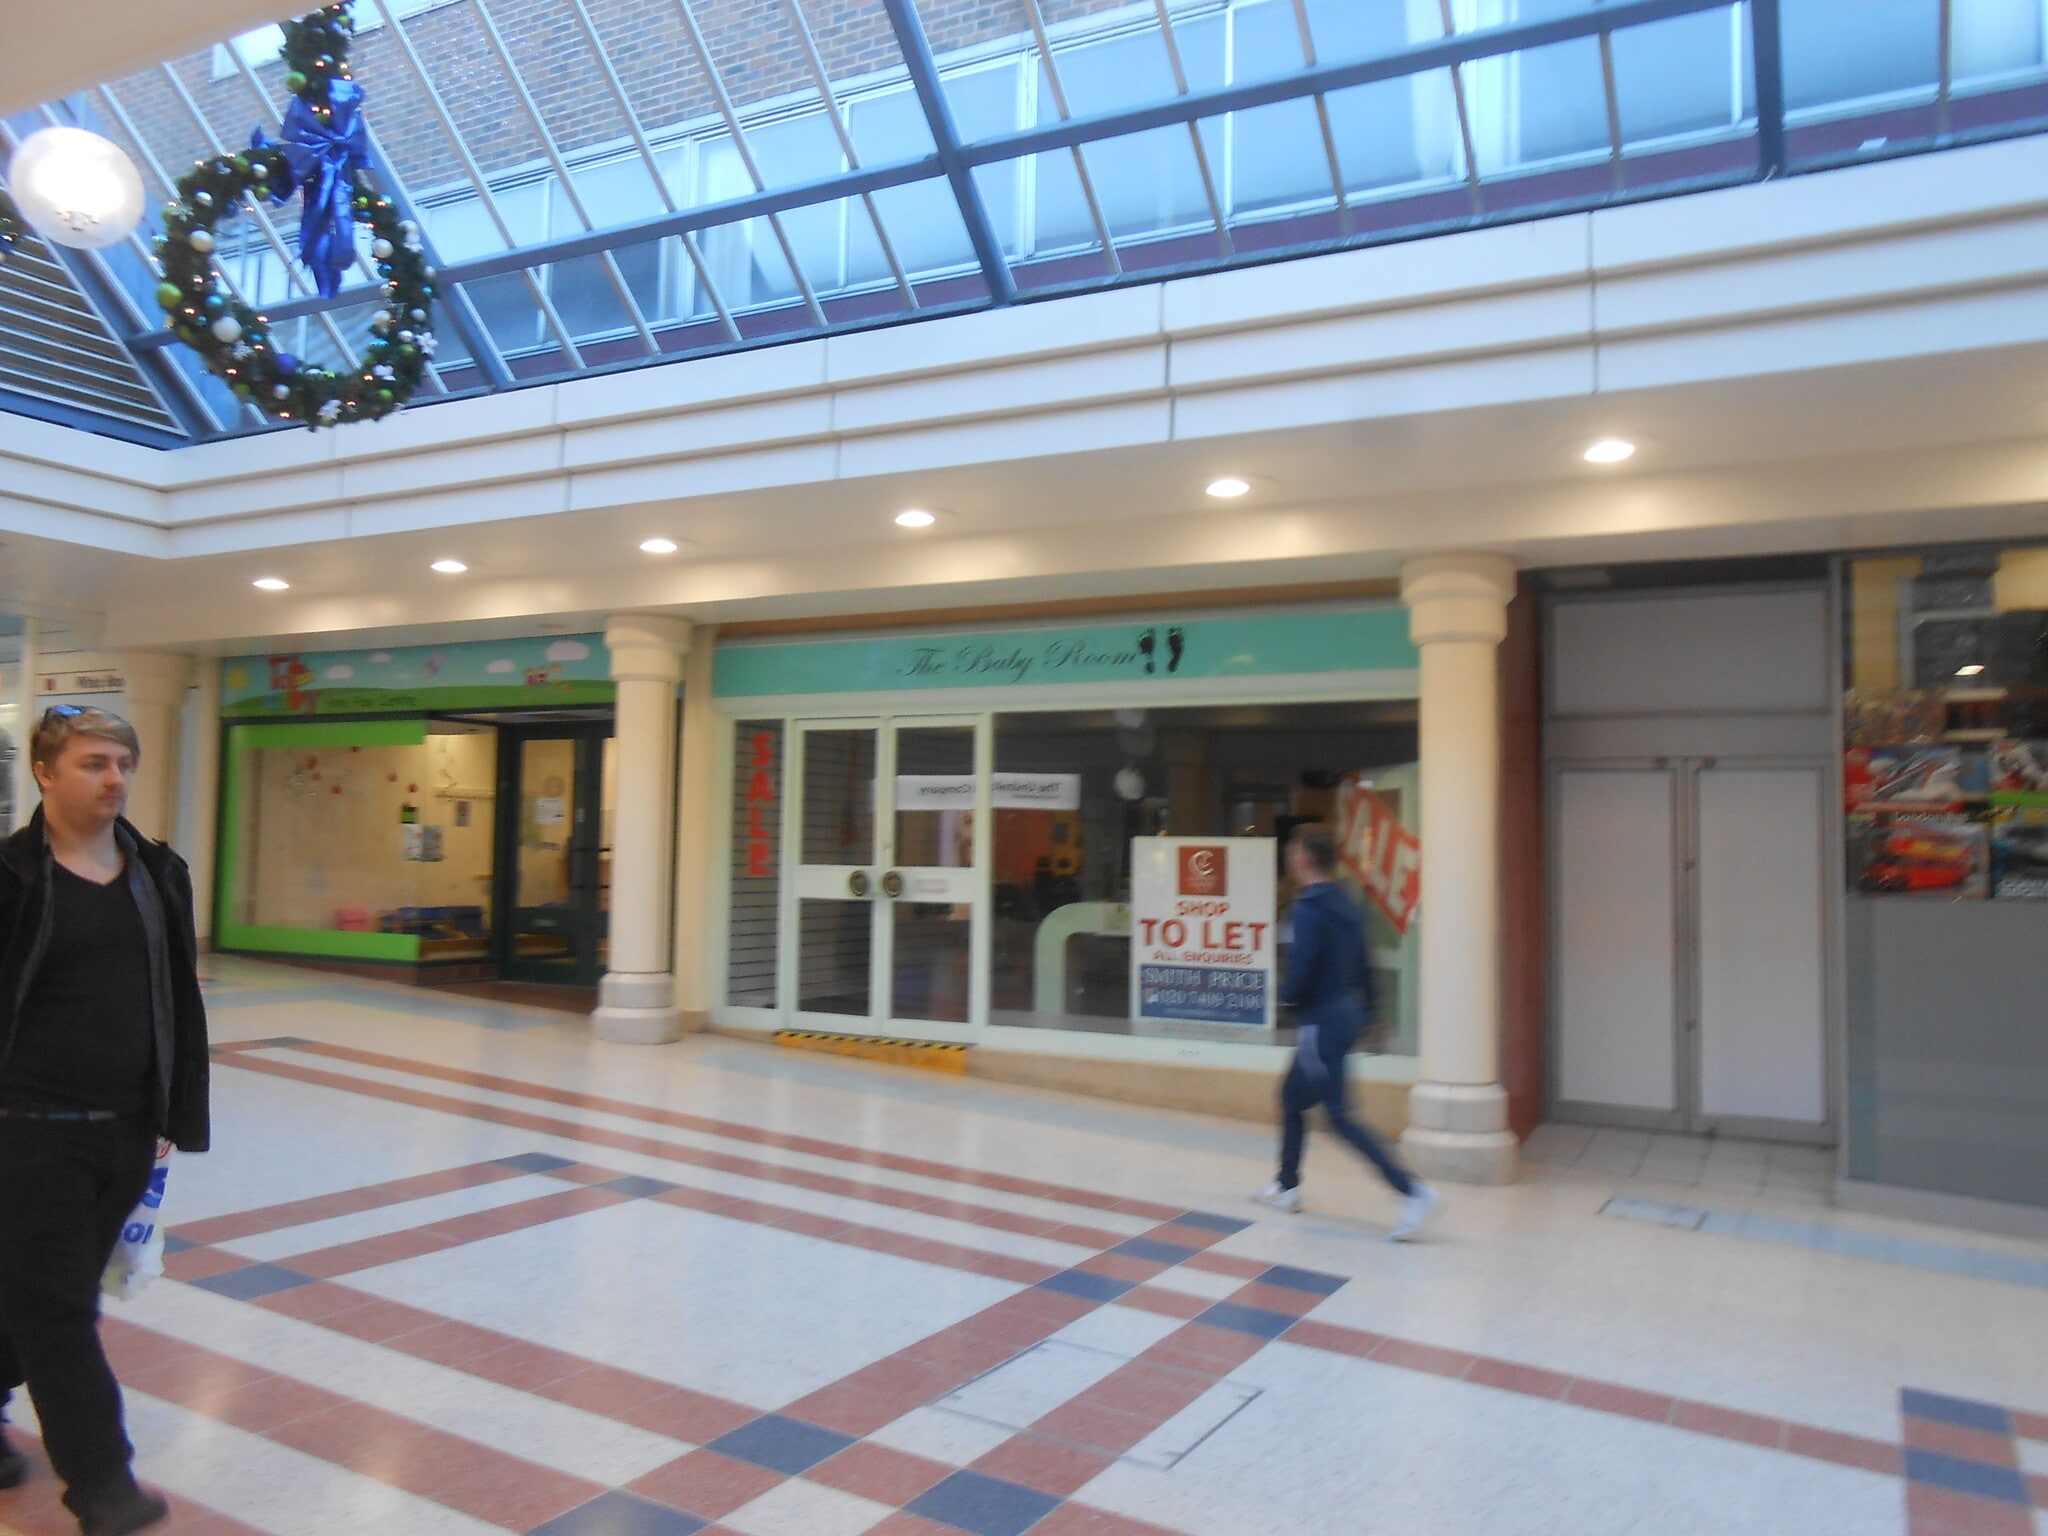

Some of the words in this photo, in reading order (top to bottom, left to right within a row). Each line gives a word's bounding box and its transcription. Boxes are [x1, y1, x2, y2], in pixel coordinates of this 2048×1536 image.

[898, 648, 946, 676] The
[955, 642, 1034, 683] Baby
[1044, 637, 1137, 669] Room
[747, 731, 773, 877] SALE
[1176, 900, 1230, 917] SHOP
[1140, 918, 1188, 948] TO
[1202, 920, 1269, 951] LET
[1153, 950, 1178, 962] ALL
[1182, 951, 1255, 965] ENQUIRIES
[1142, 967, 1202, 985] SMITH
[1158, 989, 1187, 1006] 020
